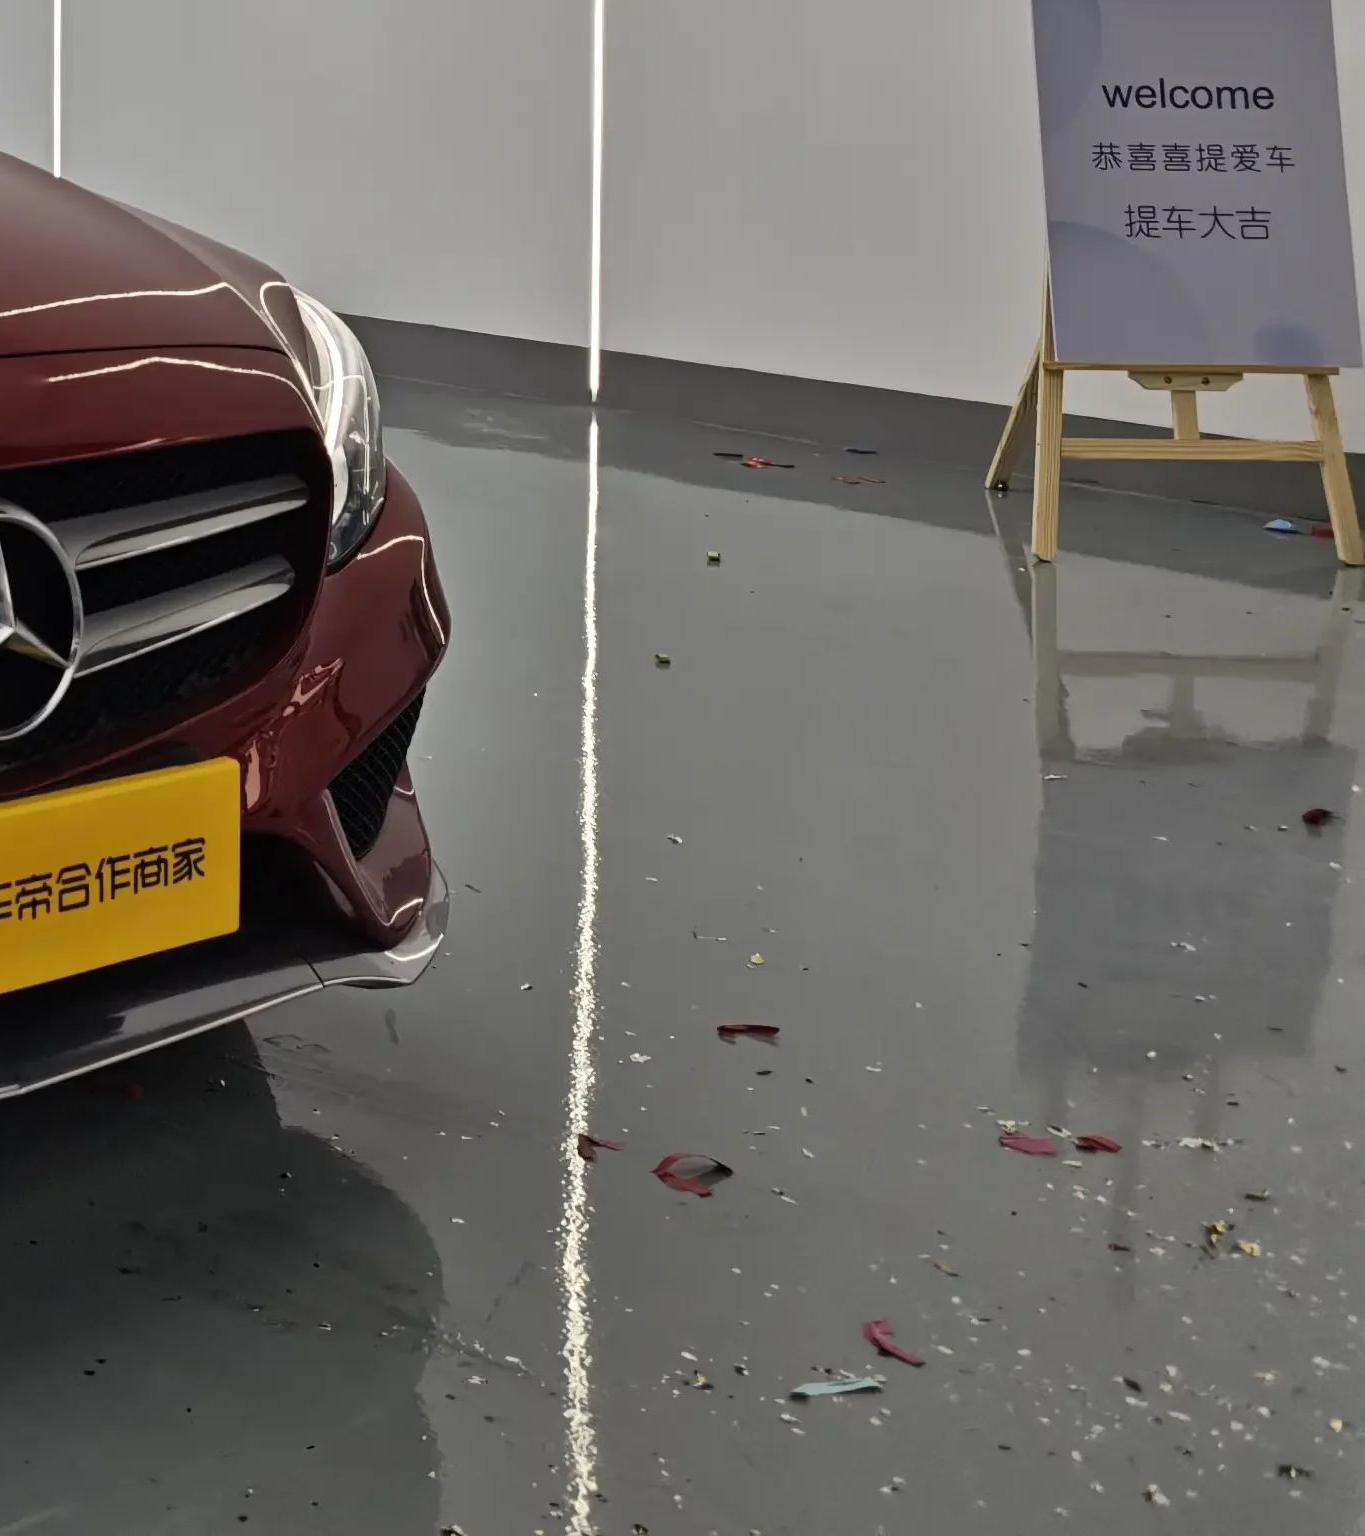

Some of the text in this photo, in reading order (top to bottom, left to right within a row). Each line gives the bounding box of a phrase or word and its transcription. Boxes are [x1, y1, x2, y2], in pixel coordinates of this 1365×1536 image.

[1101, 77, 1275, 111] welcome
[1091, 142, 1295, 175] 恭喜喜提爱车
[1124, 204, 1272, 241] 提车大吉
